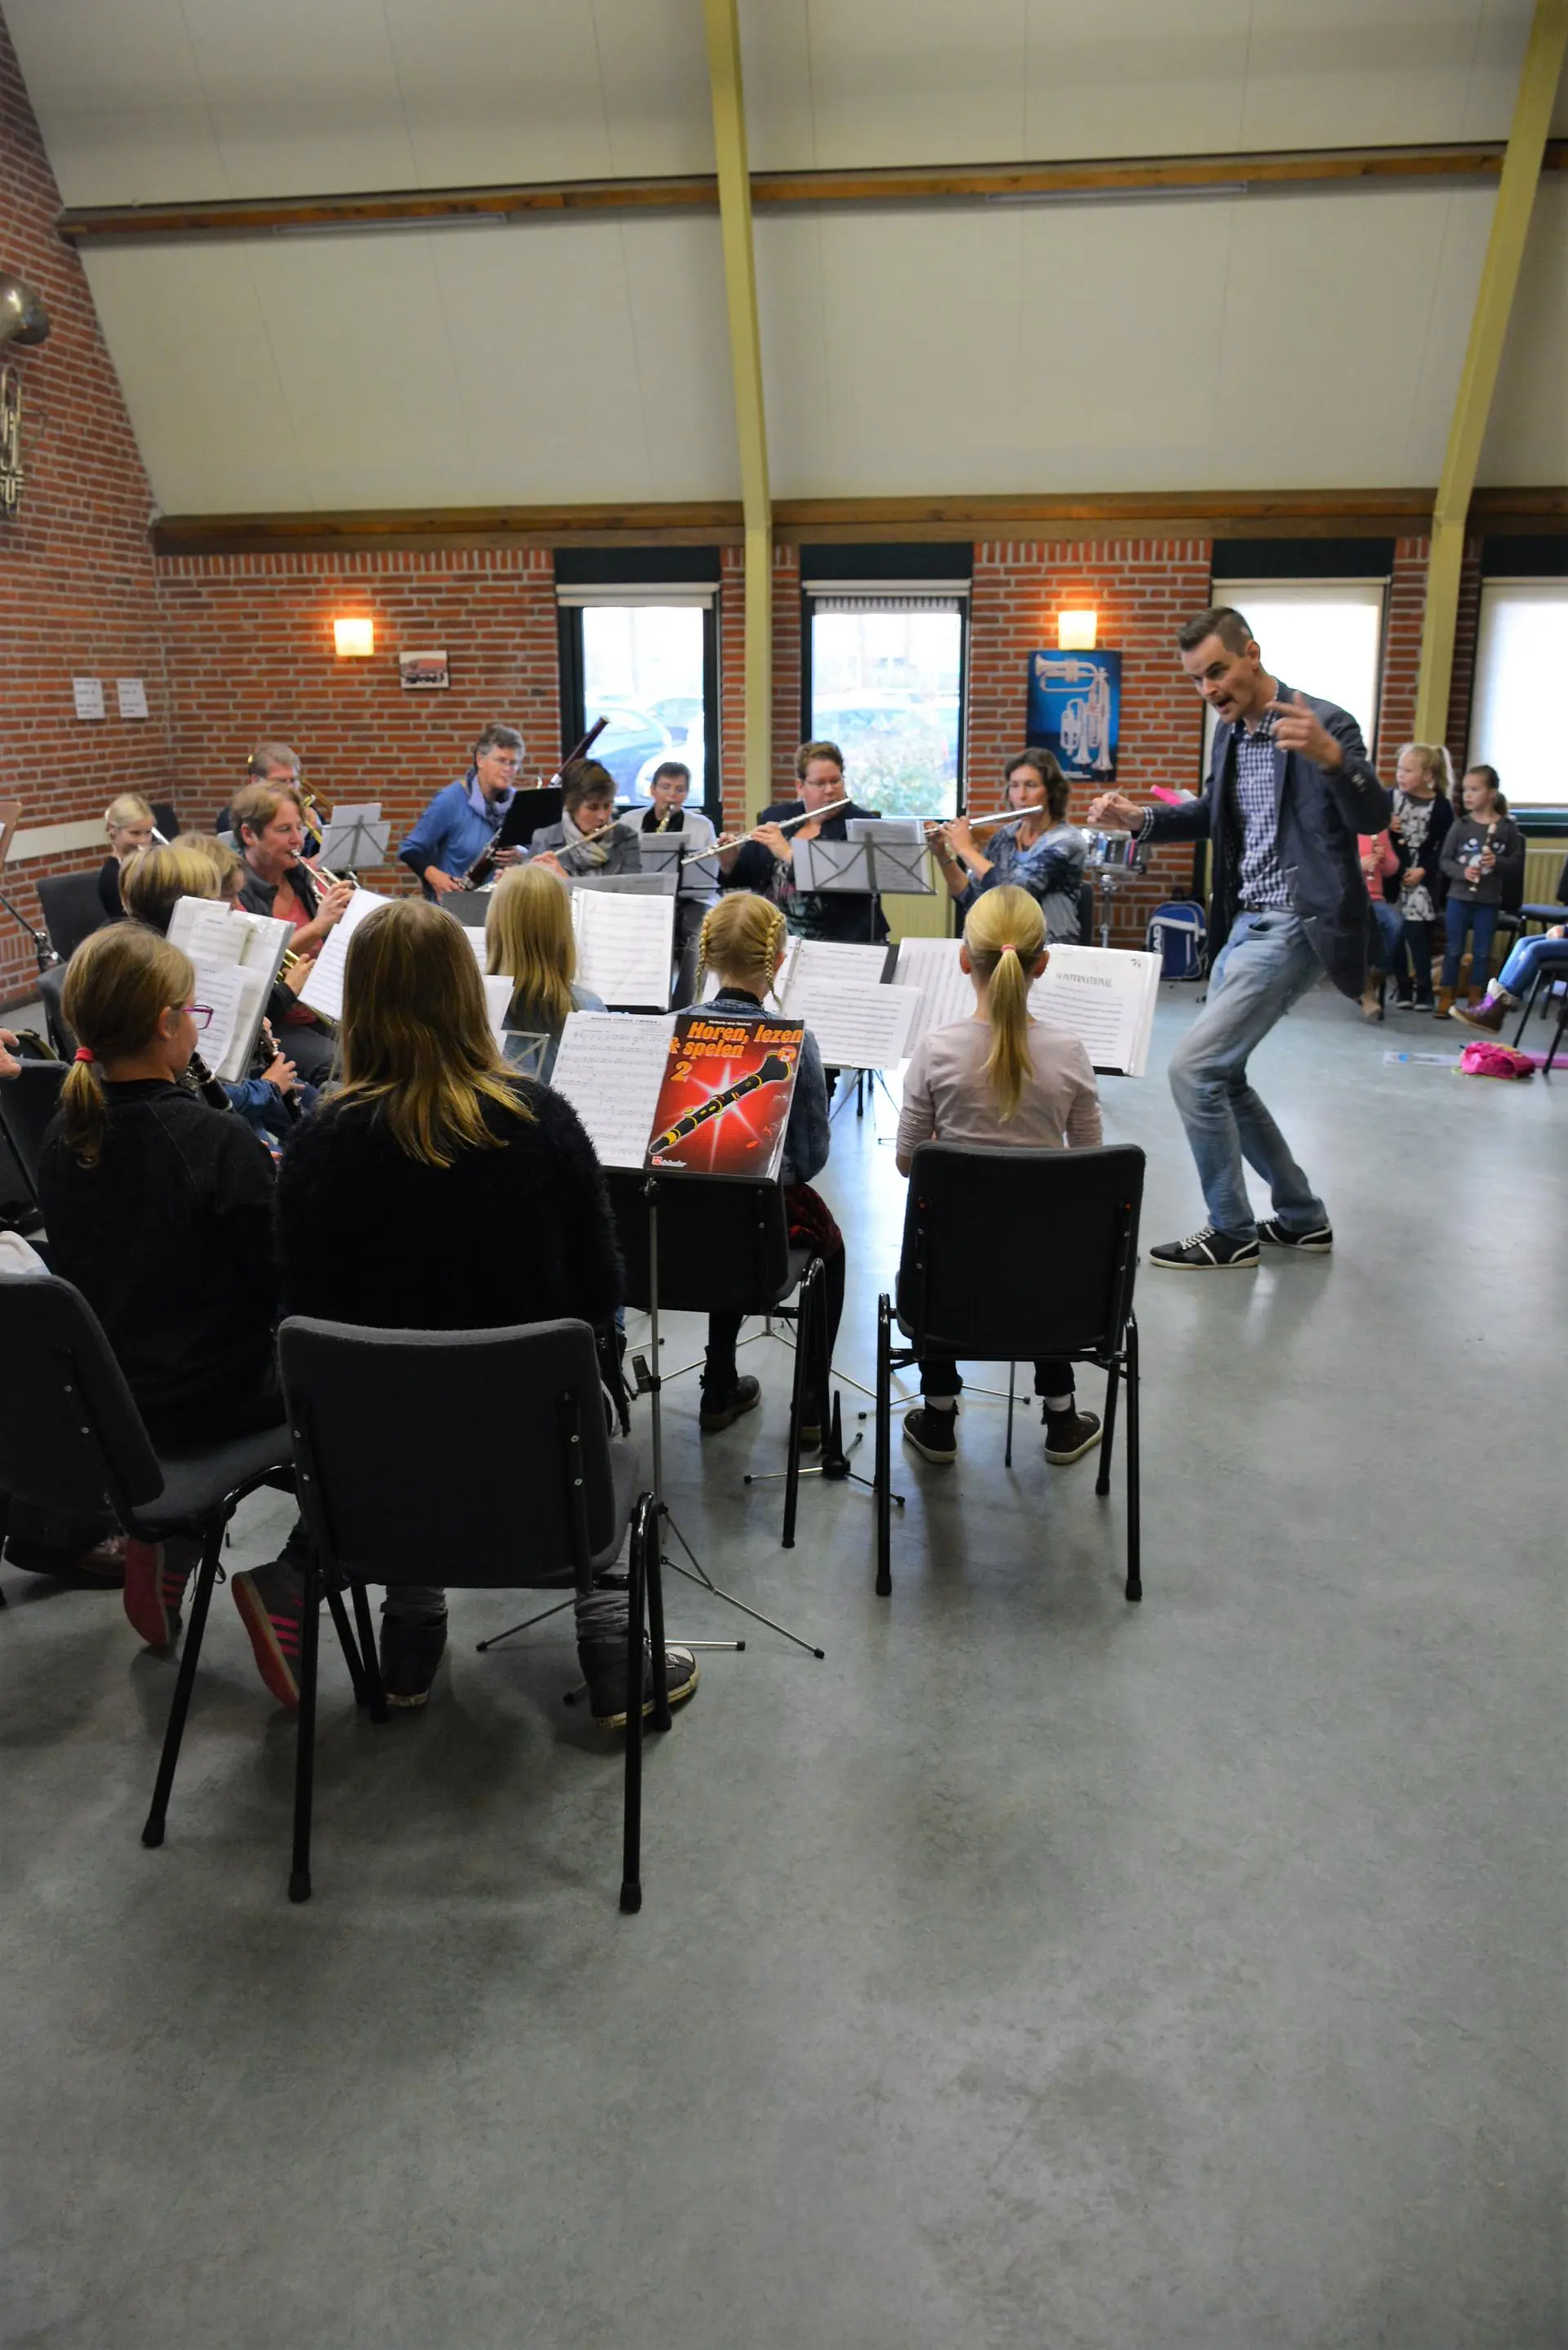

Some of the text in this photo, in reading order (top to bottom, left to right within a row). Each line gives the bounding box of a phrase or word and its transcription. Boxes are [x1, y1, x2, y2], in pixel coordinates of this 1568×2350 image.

[687, 1022, 803, 1044] Horen, lezen
[683, 1039, 745, 1059] spelen
[670, 1060, 693, 1082] 2
